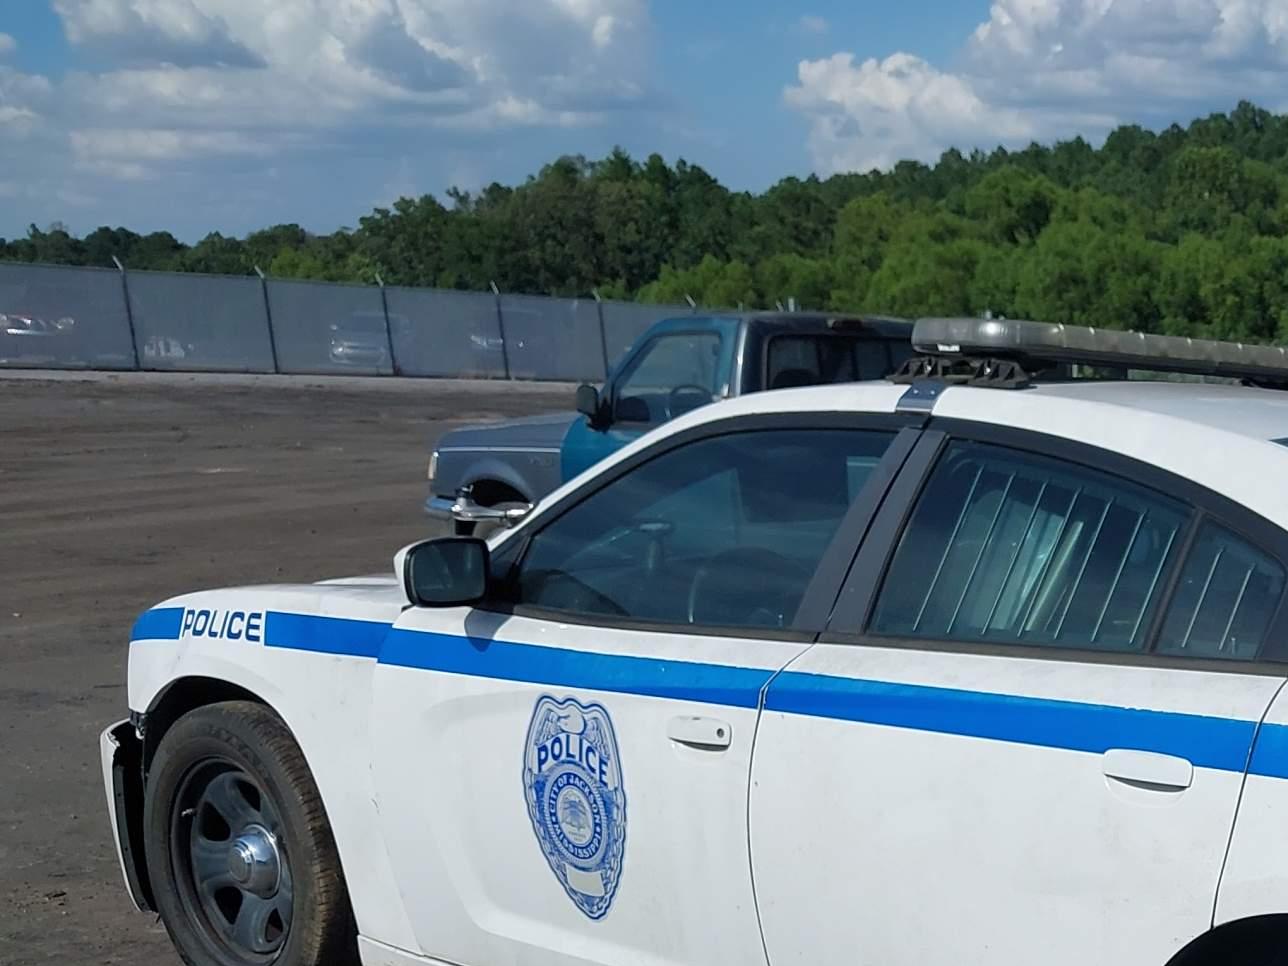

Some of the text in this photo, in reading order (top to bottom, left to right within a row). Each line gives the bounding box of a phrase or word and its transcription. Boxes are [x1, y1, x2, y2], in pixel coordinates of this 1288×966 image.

[182, 609, 262, 642] POLICE
[537, 733, 608, 788] POLICE
[568, 774, 601, 822] JACKSON
[553, 823, 601, 858] MISSISSIPPI
